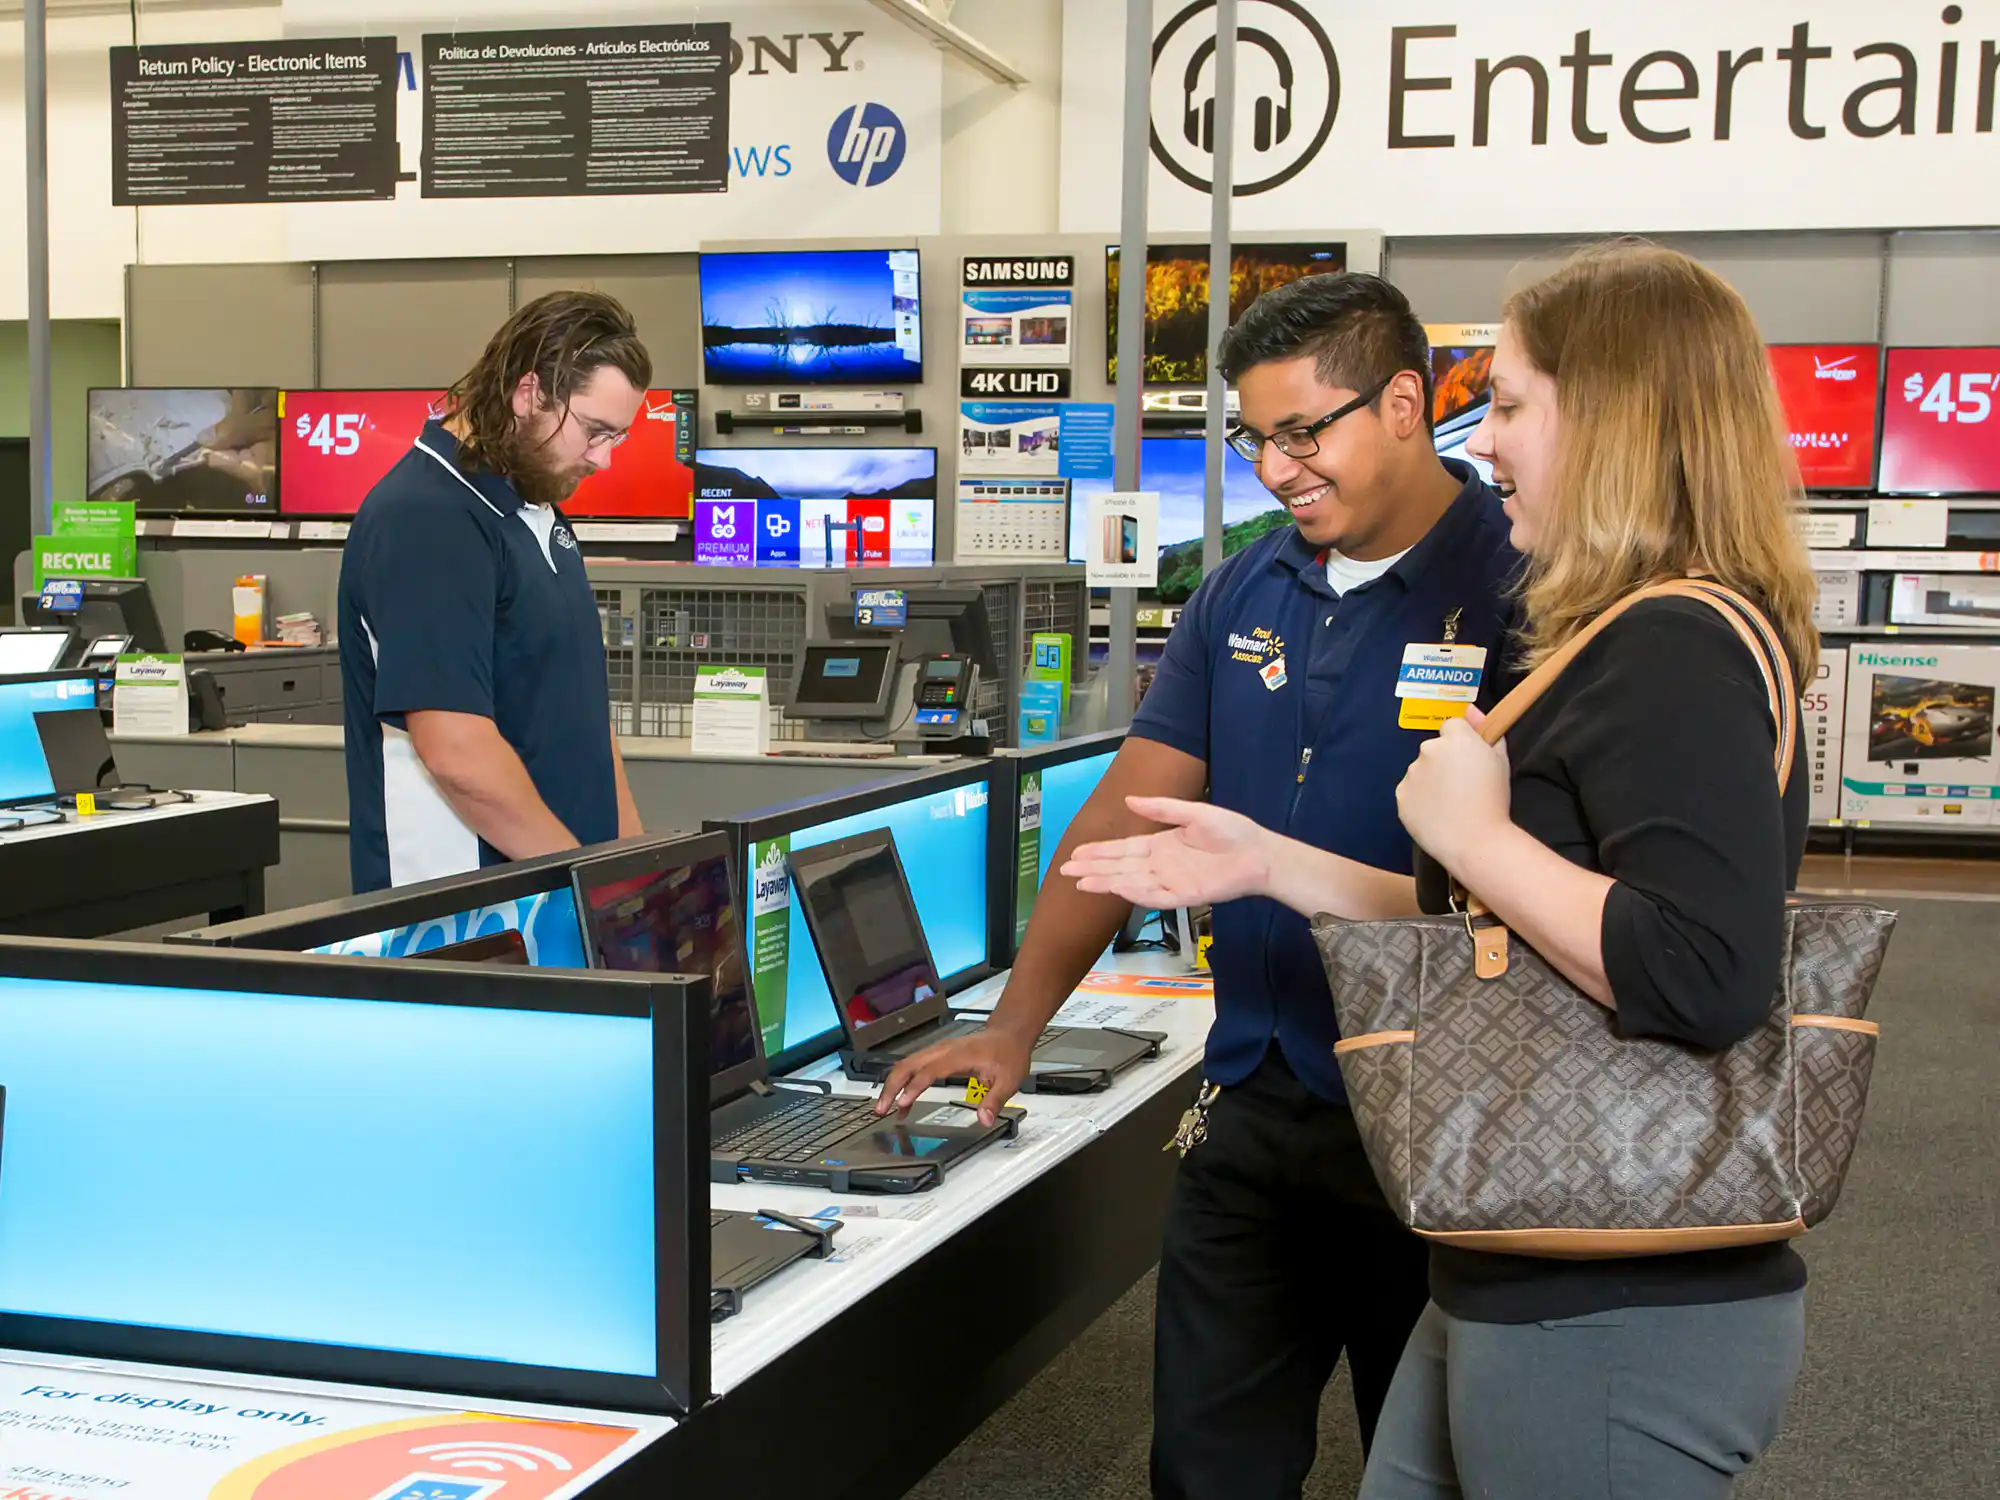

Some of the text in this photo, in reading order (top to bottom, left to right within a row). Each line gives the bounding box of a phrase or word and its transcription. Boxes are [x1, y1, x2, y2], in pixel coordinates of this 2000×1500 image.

[439, 46, 480, 60] Política
[482, 46, 498, 58] de
[499, 42, 577, 58] Devoluciones
[586, 40, 637, 55] Artículos
[639, 39, 710, 53] Electrónicos
[139, 57, 188, 76] Return
[191, 55, 235, 77] Policy
[248, 53, 321, 72] Electronic
[325, 53, 367, 69] Items
[837, 103, 897, 187] hp
[966, 261, 1069, 281] SAMSUNG
[1461, 329, 1489, 337] ULTRA
[970, 372, 1059, 393] 4K UHD
[255, 495, 266, 503] LG
[701, 488, 733, 498] RECENT
[1104, 498, 1127, 506] iPhone
[712, 505, 735, 525] M
[711, 524, 736, 539] GO
[697, 542, 750, 554] PREMIUM
[769, 550, 787, 558] Apps
[42, 552, 112, 570] RECYCLE
[736, 554, 749, 562] TV
[858, 598, 904, 607] CASH QUICK
[858, 608, 872, 624] $3
[1227, 632, 1268, 653] Walmart
[1231, 649, 1263, 664] Associate
[1423, 654, 1454, 664] Walmart
[1858, 653, 1939, 667] Hisense
[130, 667, 166, 677] Layaway
[1406, 667, 1474, 683] ARMANDO
[710, 679, 749, 690] Layaway
[1803, 693, 1829, 712] 55
[1020, 803, 1040, 822] Layaway
[1846, 800, 1870, 812] 55"
[756, 876, 790, 902] Layaway
[20, 1385, 329, 1427] For display only.
[0, 1410, 239, 1442] Buy this laptop now
[27, 1422, 68, 1433] the
[73, 1426, 174, 1444] Walmart
[8, 1466, 132, 1488] shipping
